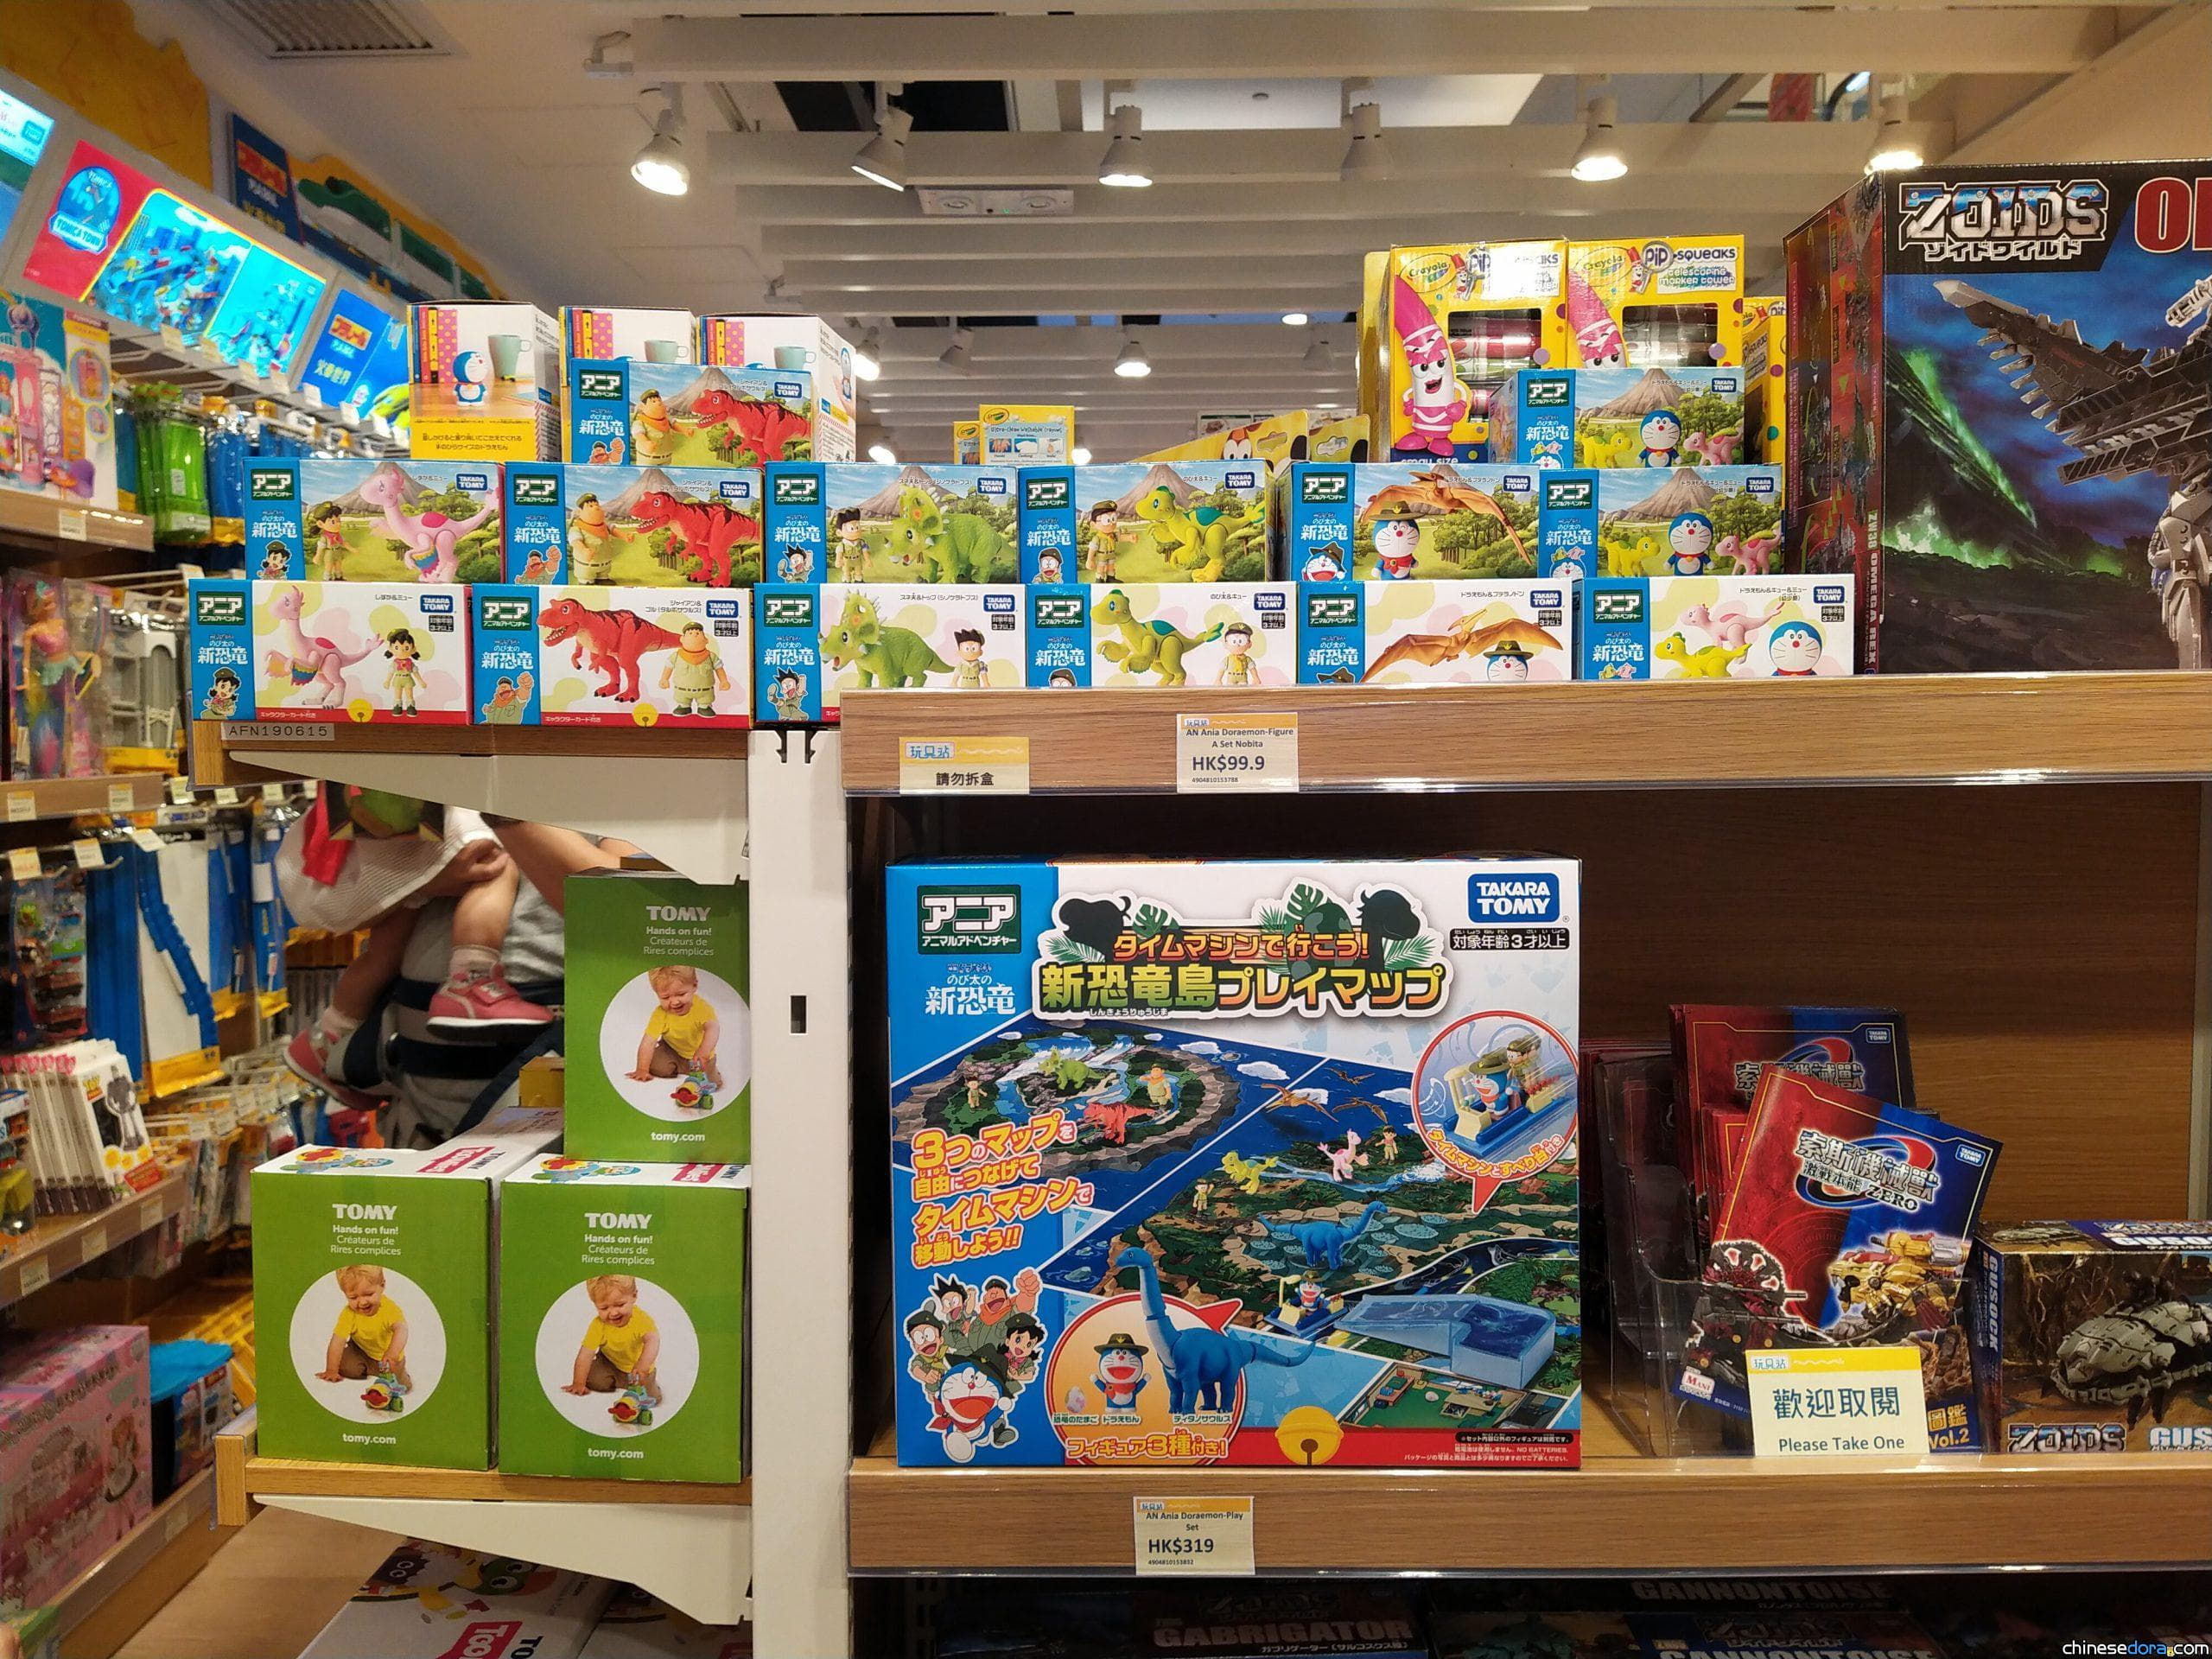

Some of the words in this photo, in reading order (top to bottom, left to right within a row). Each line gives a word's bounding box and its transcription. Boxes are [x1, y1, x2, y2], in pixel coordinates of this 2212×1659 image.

[1901, 181, 2108, 242] ZOIDS
[1925, 239, 2082, 261] ゾイドワイルド
[582, 375, 620, 390] アニア
[1529, 384, 1567, 398] アニア
[579, 420, 625, 436] 新恐竜
[1525, 426, 1569, 442] 新恐竜
[252, 474, 291, 490] アニア
[515, 479, 556, 495] アニア
[777, 479, 816, 495] アニア
[1028, 481, 1065, 499] アニア
[1303, 477, 1345, 493] アニア
[1548, 484, 1589, 500] アニア
[251, 521, 298, 538] 新恐竜
[514, 526, 561, 544] 新恐竜
[774, 526, 821, 543] 新恐竜
[1027, 529, 1071, 546] 新恐竜
[1300, 524, 1348, 541] 新恐竜
[1546, 529, 1592, 546] 新恐竜
[1867, 513, 1878, 550] ZW38
[1869, 552, 1878, 623] OMEGA
[199, 596, 242, 614] アニア
[423, 603, 450, 612] TOMY
[484, 602, 529, 620] アニア
[766, 600, 810, 617] アニア
[1038, 601, 1081, 617] アニア
[1311, 600, 1355, 617] アニア
[1596, 594, 1640, 613] アニア
[1592, 644, 1644, 663] 新恐竜
[1868, 626, 1878, 664] REX
[197, 647, 248, 665] 新恐竜
[481, 652, 533, 671] 新恐竜
[764, 648, 815, 666] 新恐竜
[1035, 649, 1086, 667] 新恐竜
[1306, 648, 1359, 666] 新恐竜
[228, 726, 328, 737] AFN190615
[1222, 728, 1294, 736] Doraemon-Figure
[1236, 740, 1263, 748] Nobita
[1192, 753, 1265, 772] HK$99.9
[936, 772, 995, 786] 請勿拆盒
[1476, 880, 1551, 897] TAKARA
[645, 906, 712, 922] TOMY
[922, 893, 1017, 932] アニア
[1476, 896, 1551, 915] TOMY
[645, 926, 676, 936] Hands
[692, 926, 712, 936] fun!
[695, 937, 708, 947] de
[922, 935, 1017, 947] アニマルアドベンチャー
[1113, 930, 1370, 962] タイムマシンで行こう!
[1452, 932, 1567, 950] 対象年齢3才以上
[643, 946, 665, 955] Rires
[667, 946, 714, 957] complices
[947, 974, 992, 985] のび太の
[1042, 966, 1444, 1008] 新恐竜島プレイマップ
[925, 982, 1016, 1016] 新恐竜
[1090, 1007, 1169, 1017] しんきょうりゅうじま
[651, 1132, 706, 1143] tomy.com
[913, 1112, 1077, 1167] 3つのマップを
[1957, 1152, 1983, 1166] TOMY
[1959, 1146, 1985, 1160] TAKARA
[1796, 1129, 1941, 1204] 索斯機械獸
[914, 1155, 1040, 1200] 自由につなげて
[915, 1178, 1092, 1236] タイムマシンで
[1866, 1184, 1919, 1213] ZERO
[332, 1204, 397, 1221] TOMY
[584, 1212, 653, 1230] TOMY
[333, 1224, 363, 1234] Hands
[379, 1224, 399, 1236] fun!
[584, 1234, 616, 1244] Hands
[633, 1233, 653, 1244] fun!
[336, 1234, 380, 1245] Créateurs
[382, 1236, 395, 1246] de
[330, 1244, 353, 1255] Rires
[354, 1245, 401, 1257] complices
[588, 1243, 634, 1255] Créateurs
[635, 1245, 649, 1255] de
[582, 1254, 604, 1264] Rires
[606, 1254, 655, 1267] complices
[1988, 1255, 1999, 1352] GUSOCK
[1773, 1387, 1900, 1420] 歡迎取閱
[1102, 1415, 1141, 1424] ドラえもん
[1173, 1415, 1232, 1424] ティタノサウルス
[342, 1432, 397, 1446] tomy.com
[1067, 1433, 1228, 1459] フィギュア3種付き!
[1778, 1436, 1827, 1452] Please
[1832, 1436, 1870, 1452] Take
[1874, 1434, 1905, 1451] One
[1928, 1428, 1970, 1450] Vol.2
[2008, 1423, 2127, 1453] ZOIDS
[588, 1447, 644, 1460] tomy.com
[1181, 1511, 1243, 1521] Doraemon-Play
[1148, 1537, 1214, 1555] HK$319
